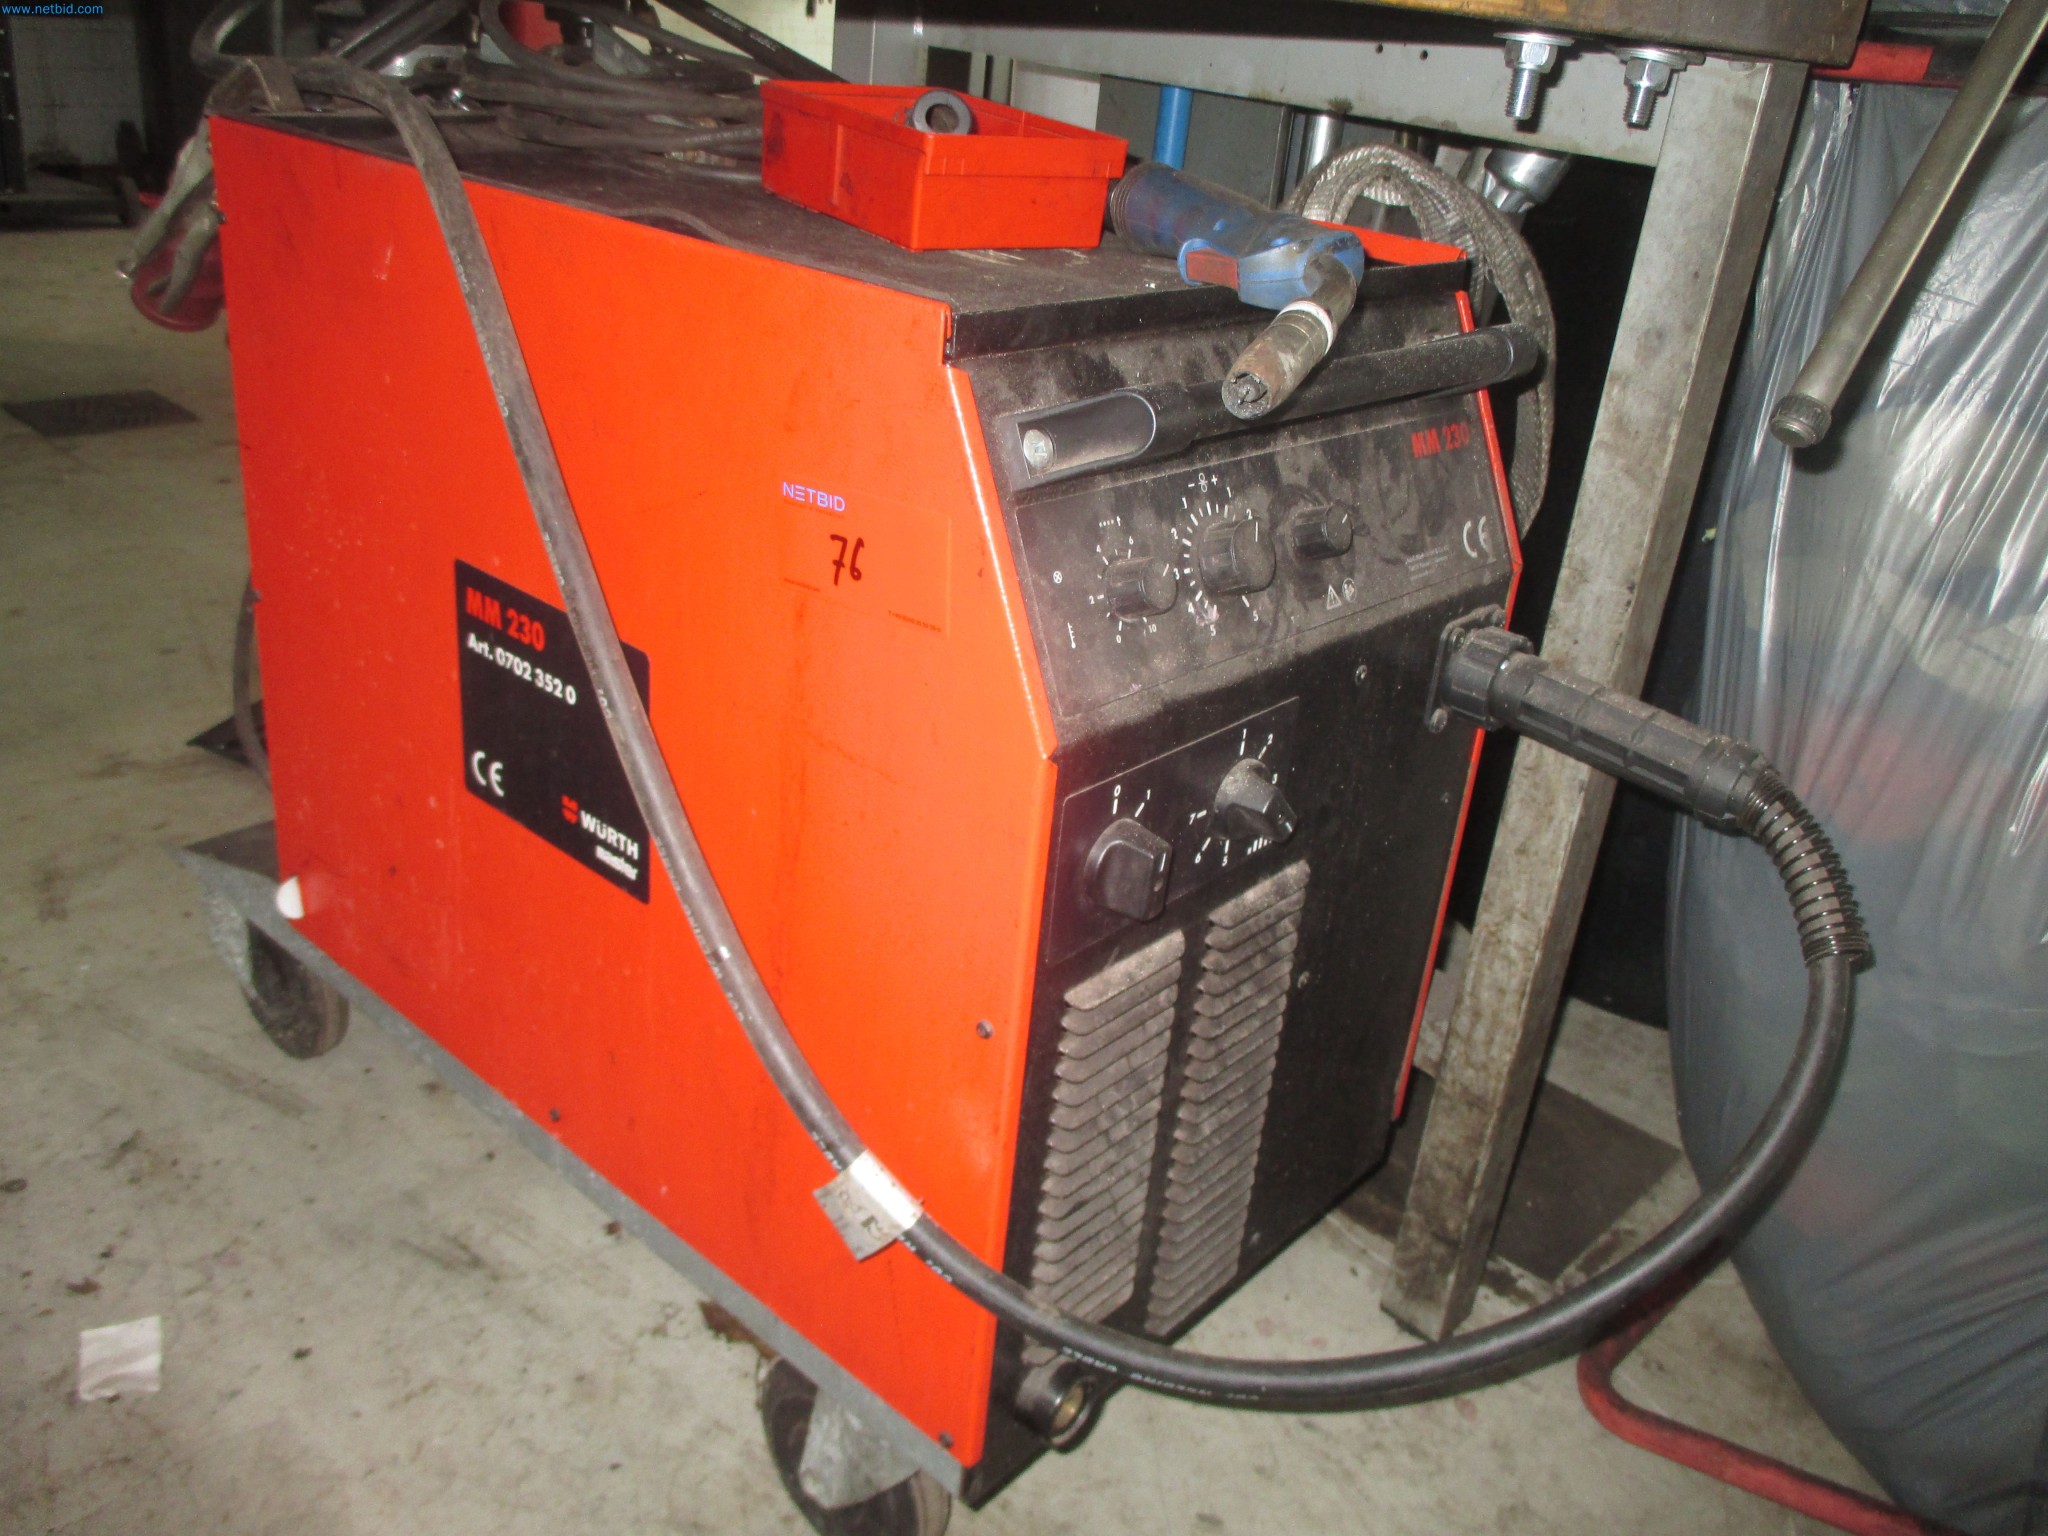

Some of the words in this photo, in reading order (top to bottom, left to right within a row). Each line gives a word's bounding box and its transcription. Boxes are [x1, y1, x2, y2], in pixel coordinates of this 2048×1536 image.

[1411, 428, 1441, 458] MM
[1441, 421, 1469, 449] 230
[783, 481, 845, 512] NETBID
[1171, 527, 1179, 540] 2
[1128, 535, 1134, 545] 6
[830, 534, 865, 586] 76
[1173, 567, 1180, 580] 3
[1089, 595, 1095, 605] 2
[1187, 602, 1195, 614] 4
[466, 586, 502, 630] MM
[506, 608, 546, 652] 230
[1252, 610, 1259, 622] 5
[1148, 623, 1157, 634] 10
[1209, 624, 1217, 637] 5
[1116, 634, 1122, 644] 0
[467, 632, 494, 660] Art.
[495, 647, 532, 682] 0702
[534, 668, 564, 699] 352
[564, 685, 576, 705] 0
[1268, 733, 1274, 745] 2
[472, 751, 504, 797] CE
[1113, 784, 1121, 797] 0
[1146, 789, 1151, 801] 1
[1189, 813, 1196, 825] 7
[580, 809, 639, 860] WÜRTH
[1195, 852, 1201, 864] 6
[1222, 855, 1228, 867] 5
